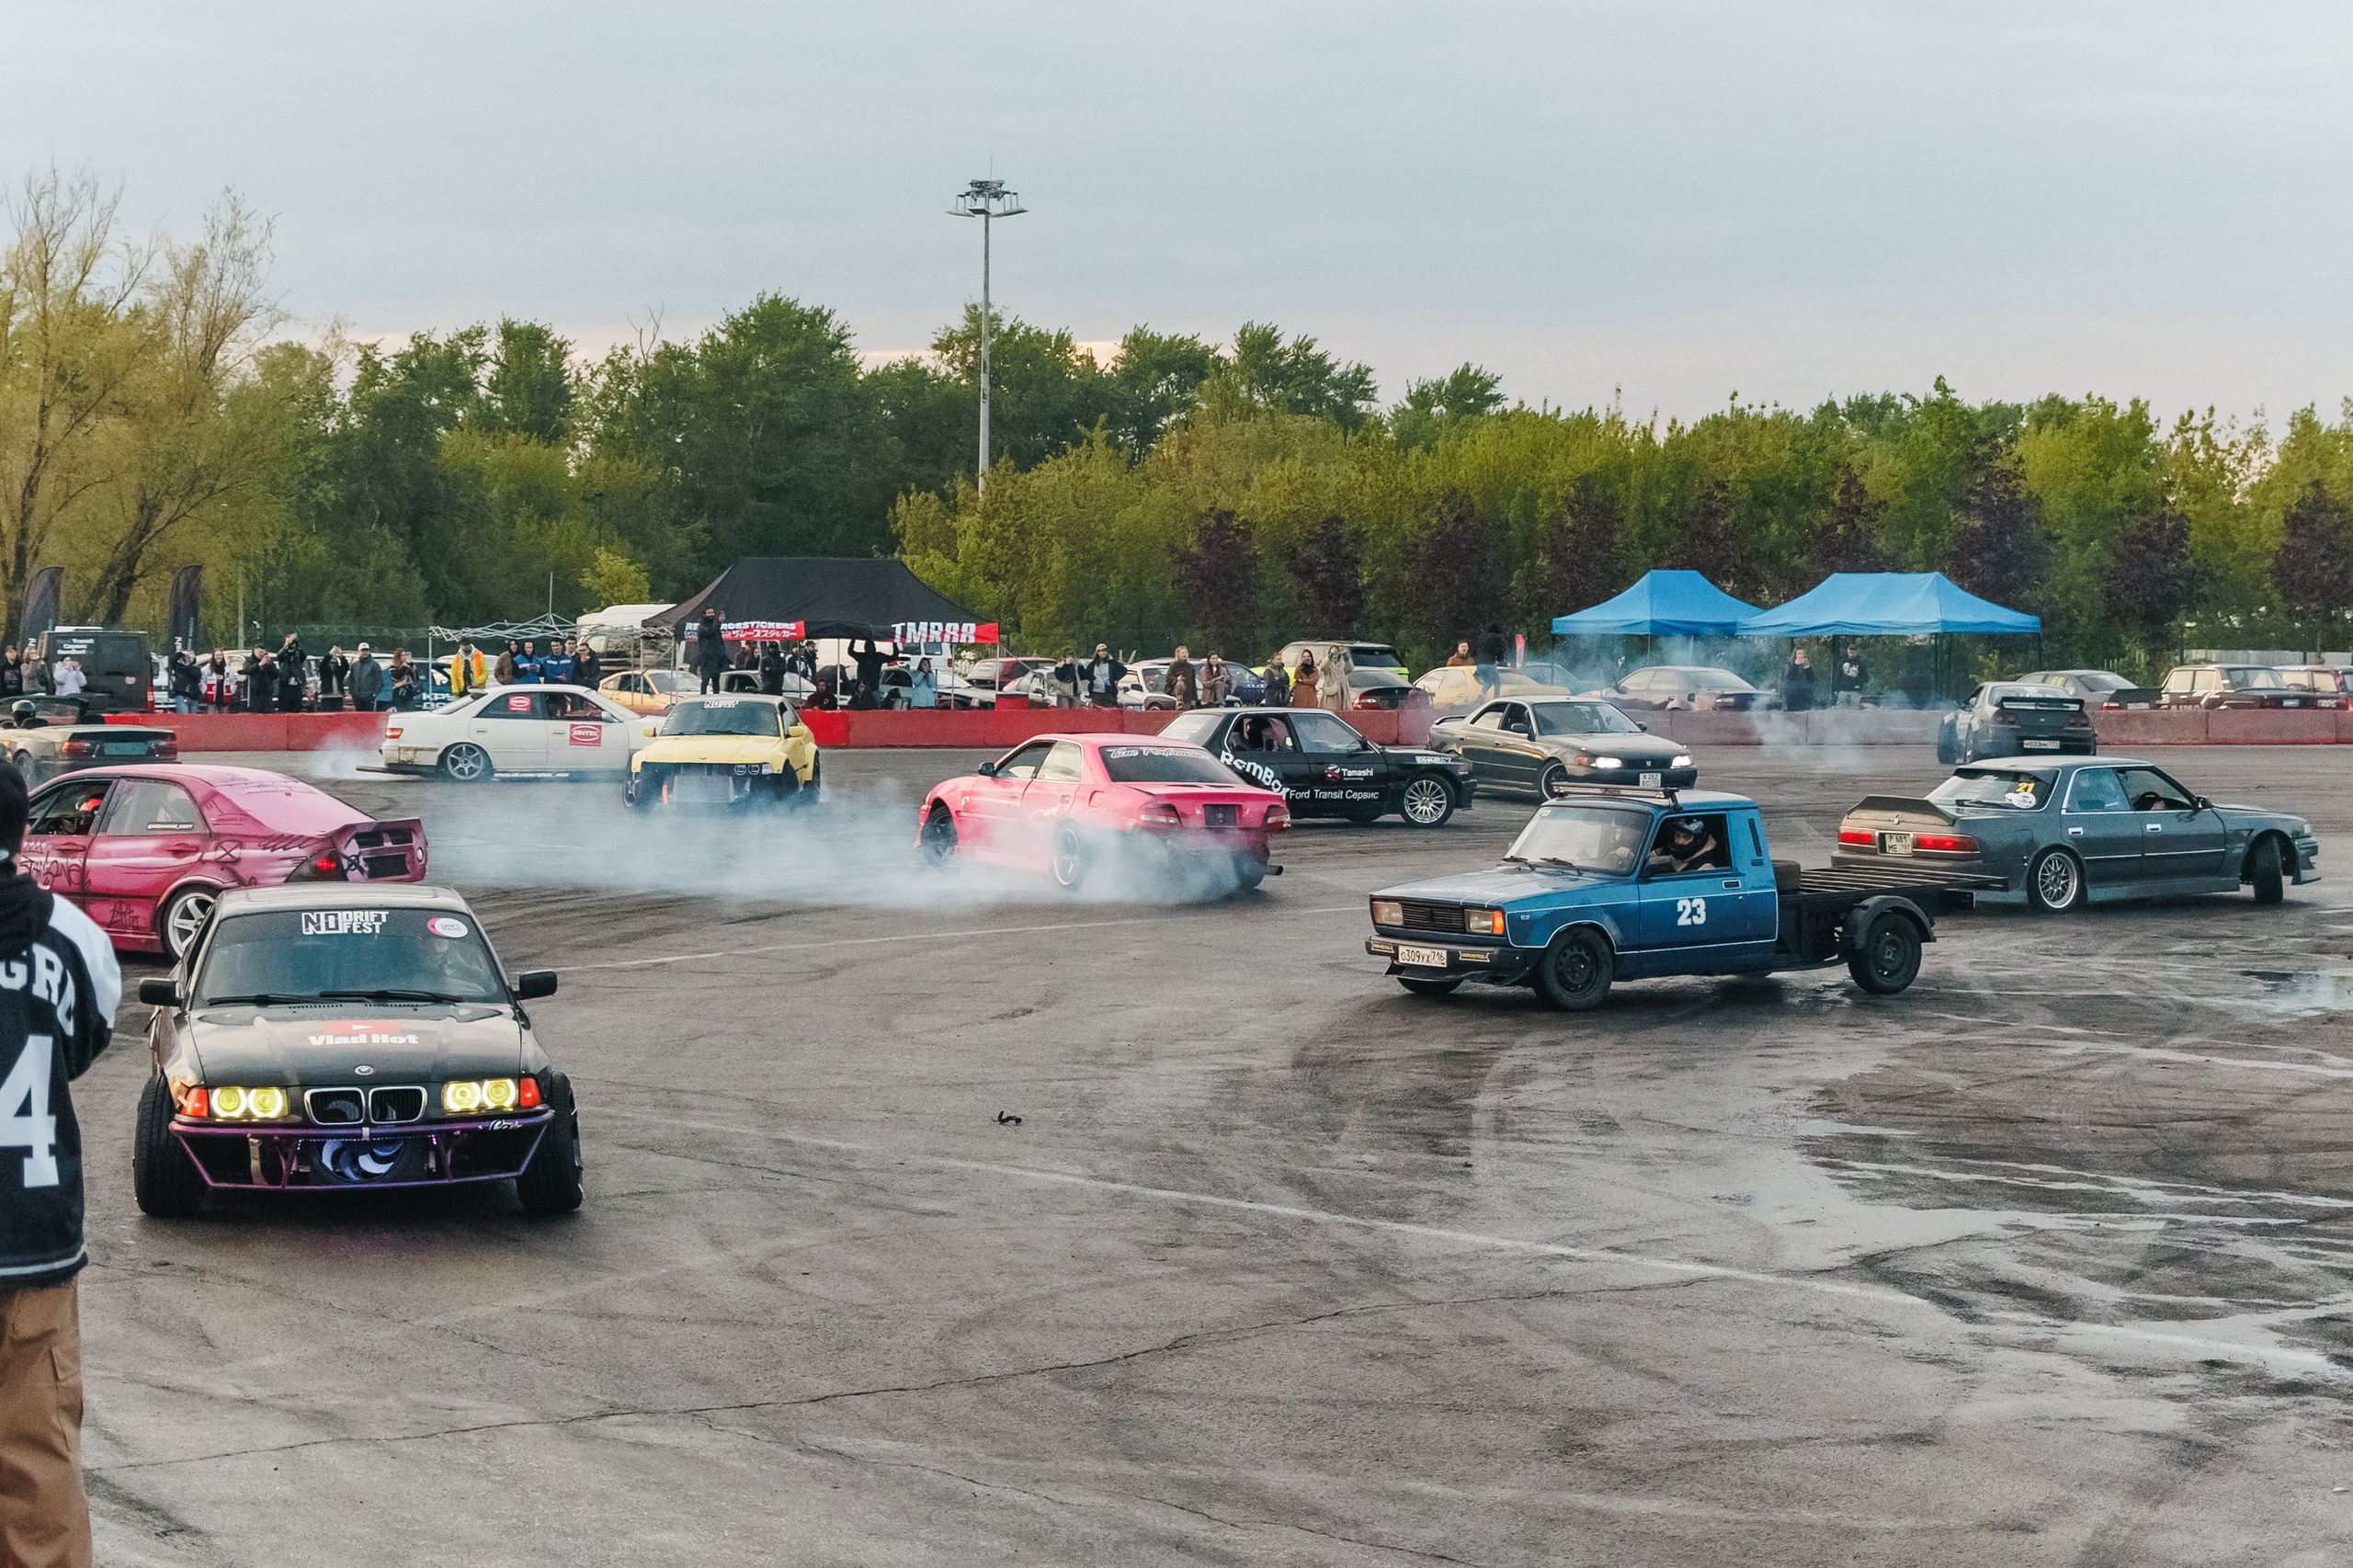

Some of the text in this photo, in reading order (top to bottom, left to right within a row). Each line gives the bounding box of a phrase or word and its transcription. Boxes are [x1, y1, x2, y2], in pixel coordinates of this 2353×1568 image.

[892, 621, 976, 643] TMR88
[1341, 768, 1374, 777] Tamashi
[2017, 782, 2035, 793] 21
[1289, 789, 1380, 801] Ford Transit Сервис
[342, 911, 389, 923] DRIFT
[1677, 897, 1707, 926] 23
[343, 922, 382, 934] FEST
[308, 1033, 419, 1045] Vlad Hot
